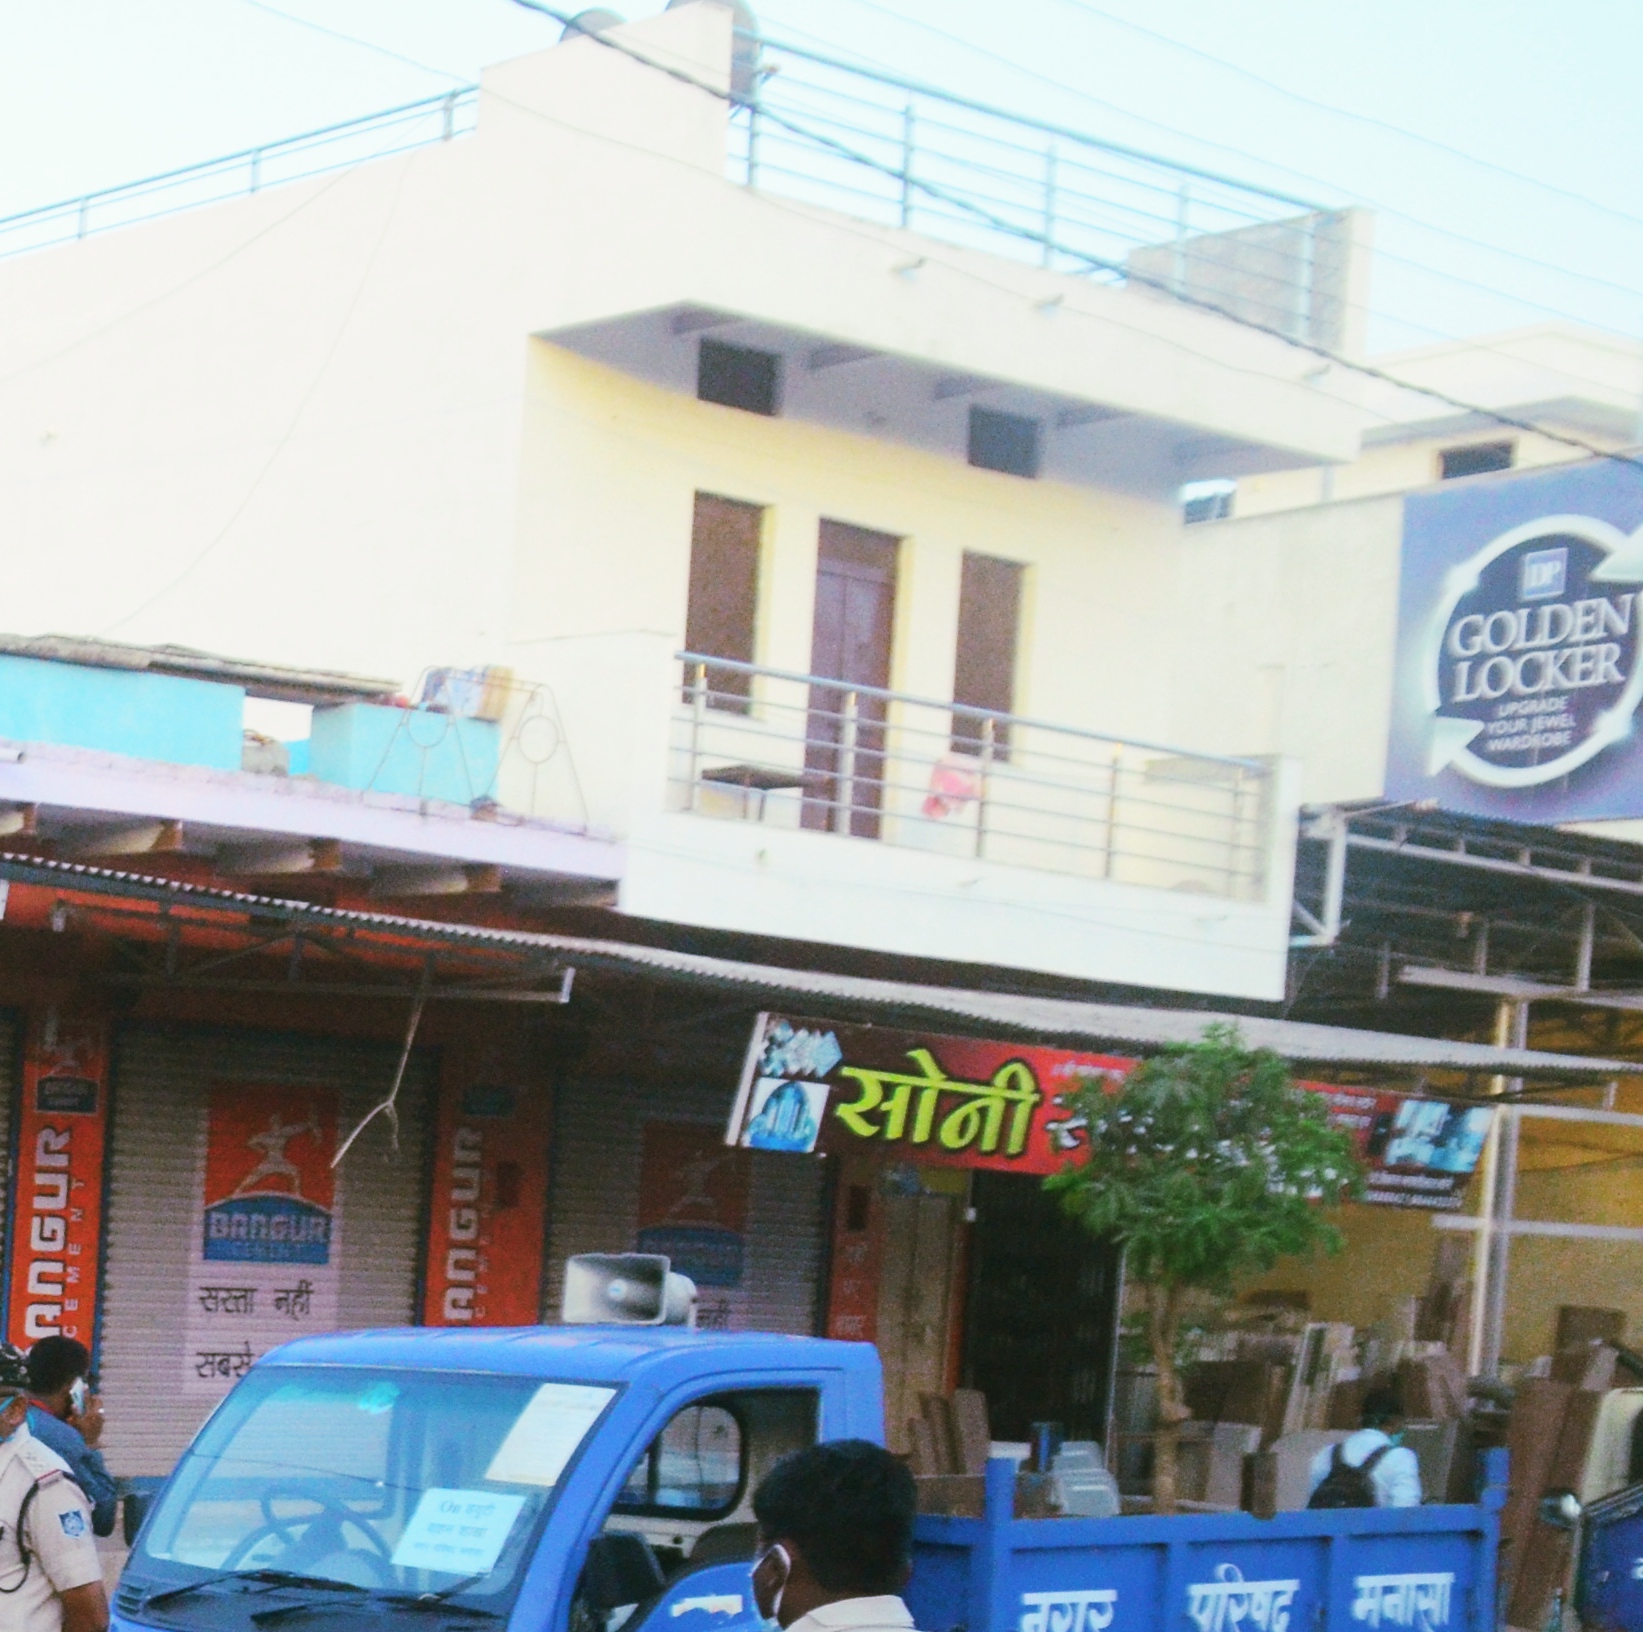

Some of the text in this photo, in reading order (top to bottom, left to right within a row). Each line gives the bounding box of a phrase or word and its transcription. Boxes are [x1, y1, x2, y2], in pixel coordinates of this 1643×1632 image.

[1450, 595, 1634, 657] GOLDEN
[1452, 644, 1625, 702] LOCKER
[1487, 713, 1577, 735] YOUR JEWEL
[1498, 696, 1570, 718] UPGRADE
[1486, 731, 1573, 751] WARDROBE
[836, 1048, 1041, 1157] सोनी
[23, 1126, 71, 1340] ANGUR
[209, 1212, 328, 1244] BANGUR
[443, 1125, 484, 1321] ANGUR
[273, 1279, 315, 1322] नहीं
